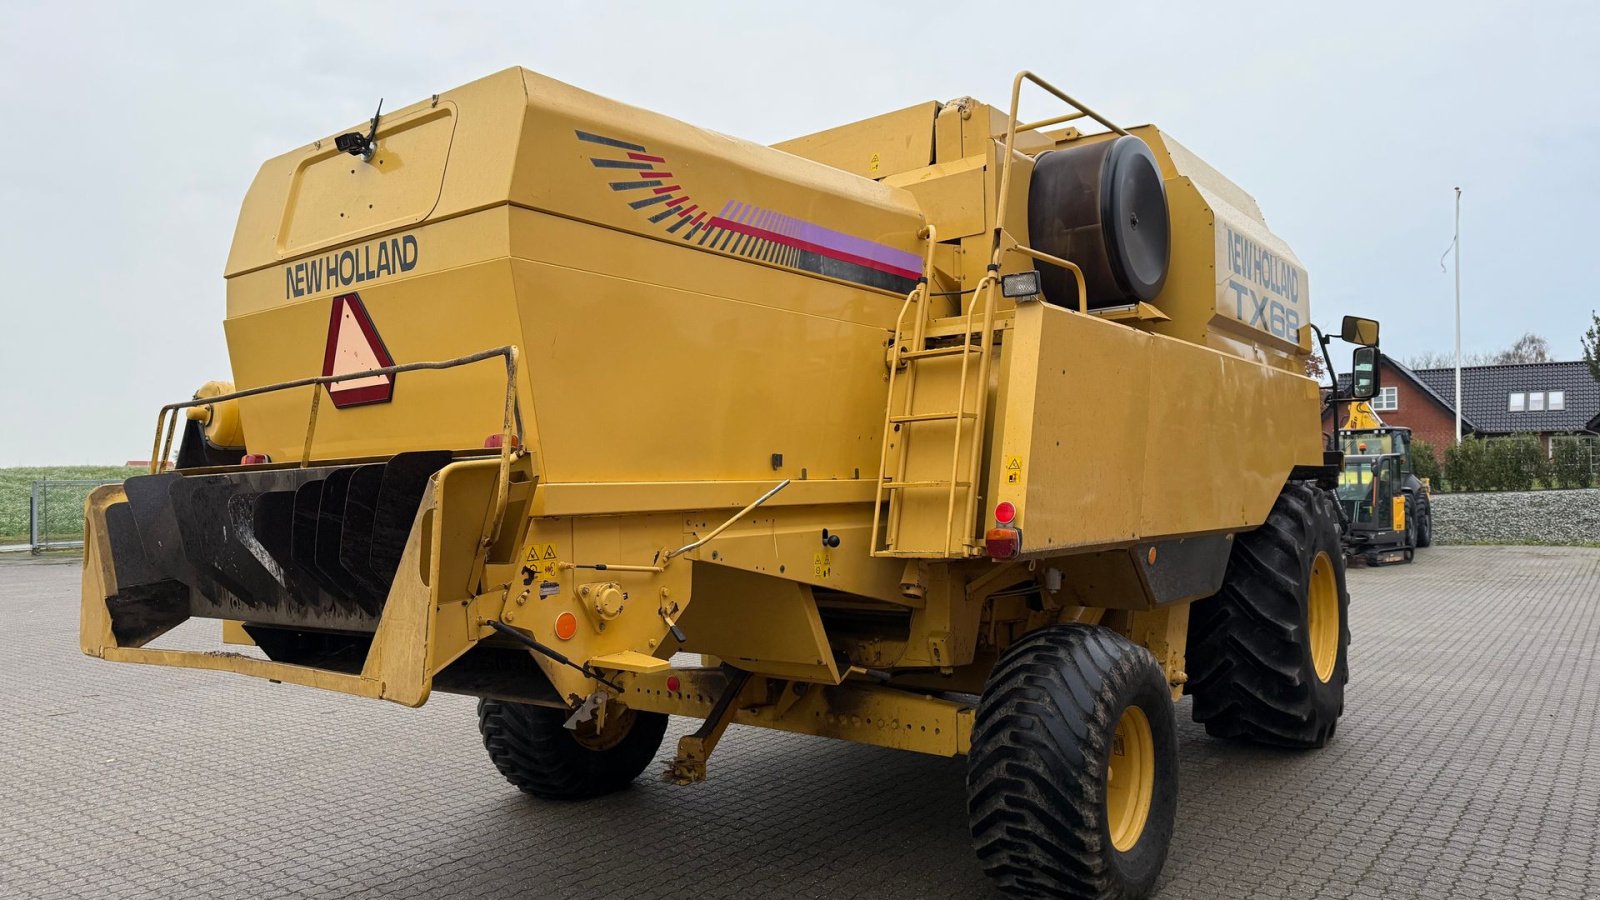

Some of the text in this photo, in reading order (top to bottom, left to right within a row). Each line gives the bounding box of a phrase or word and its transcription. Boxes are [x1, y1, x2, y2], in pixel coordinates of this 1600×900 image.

[286, 234, 418, 300] NEW HOLLAND
[1227, 229, 1299, 304] NEW HOLLAND
[1229, 279, 1300, 344] TX68
